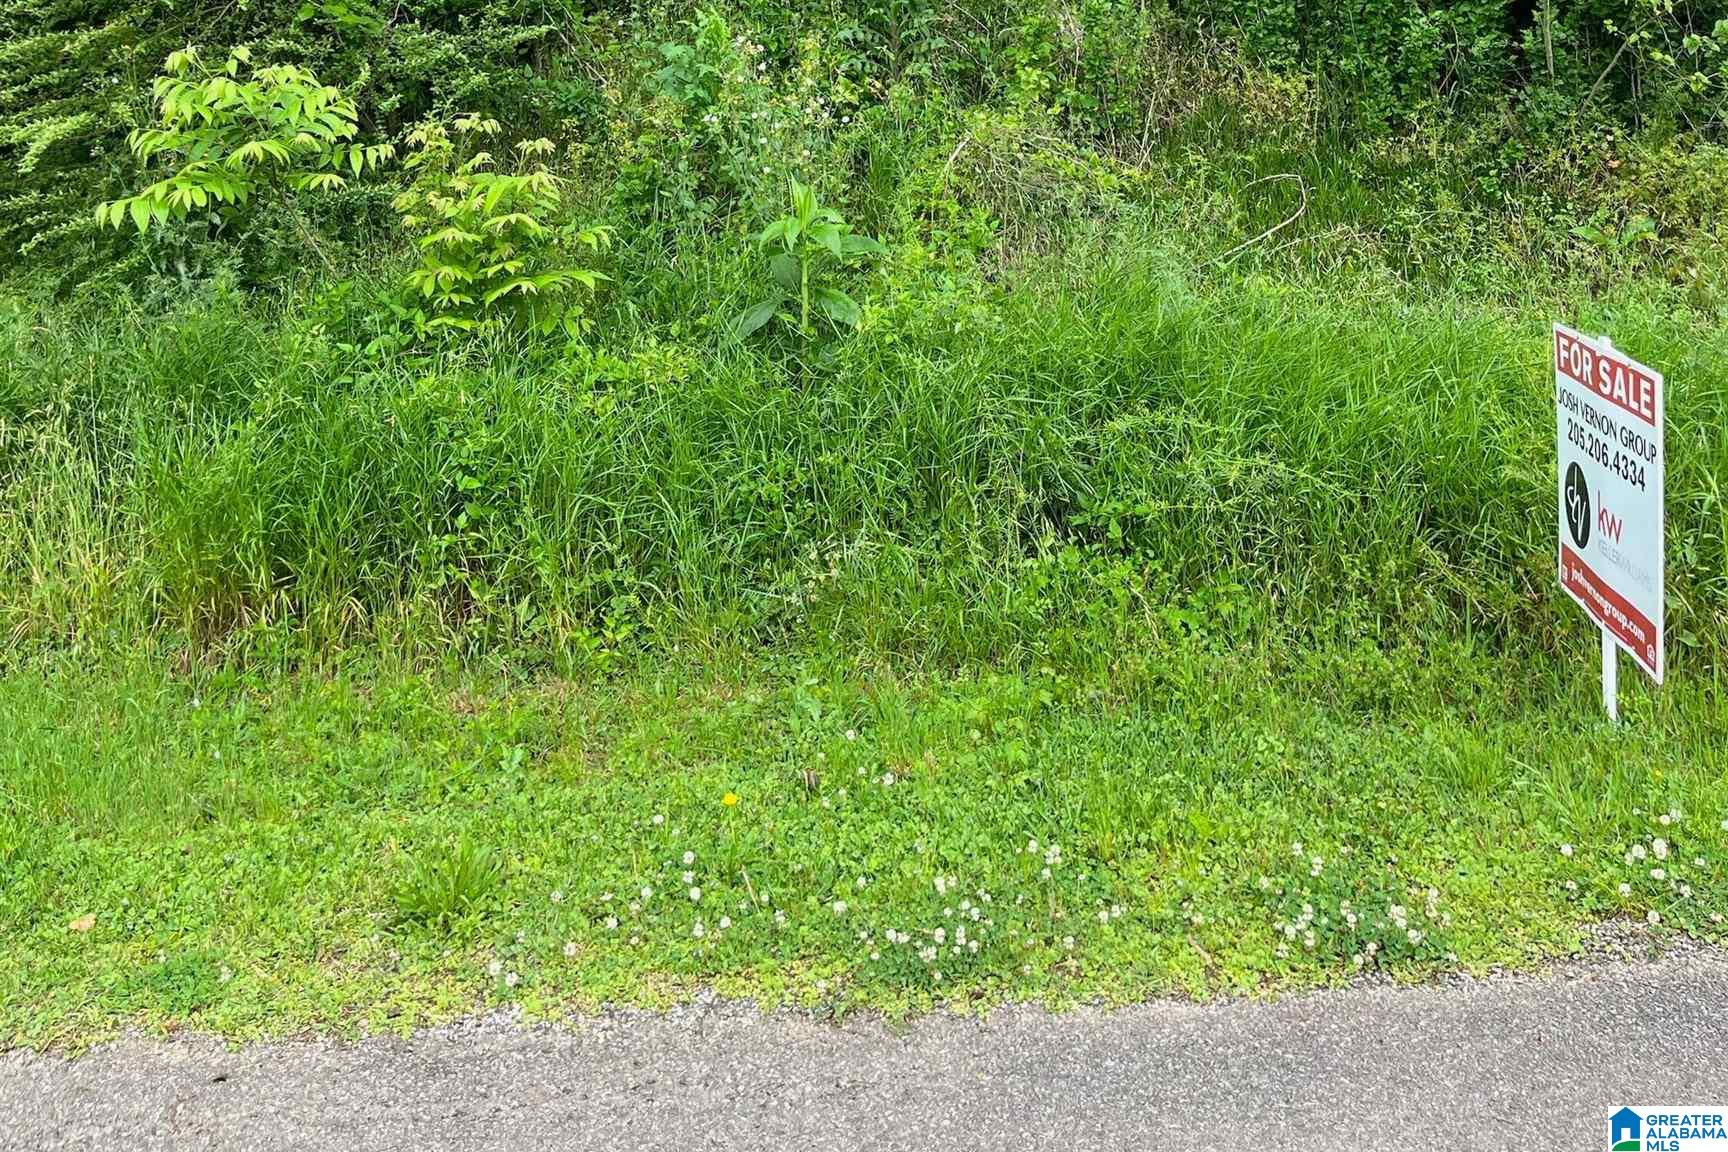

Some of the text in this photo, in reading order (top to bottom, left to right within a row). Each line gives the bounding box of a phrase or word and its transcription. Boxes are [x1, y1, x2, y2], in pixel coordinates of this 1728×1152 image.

[1558, 335, 1653, 420] FOR SALE
[1558, 386, 1657, 465] JOSH VERNON GROUP
[1567, 417, 1646, 493] 205.206.4334
